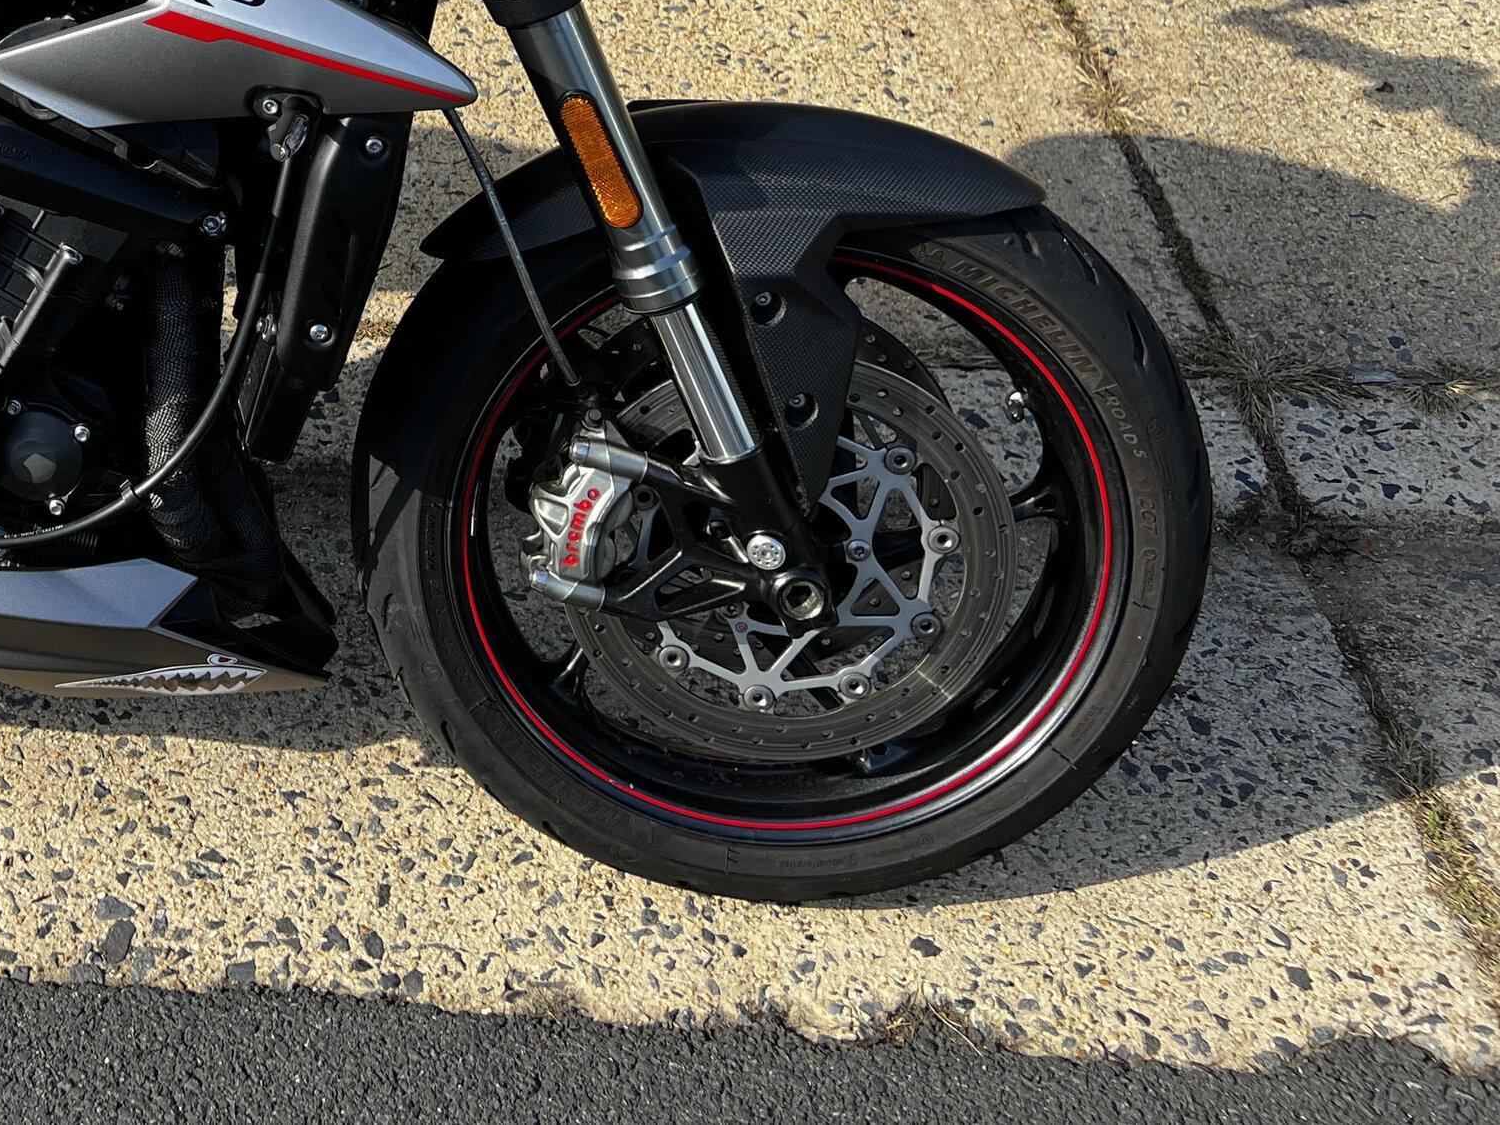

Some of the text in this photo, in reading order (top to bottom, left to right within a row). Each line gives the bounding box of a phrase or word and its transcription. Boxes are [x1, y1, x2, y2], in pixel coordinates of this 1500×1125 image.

[950, 260, 1098, 374] MICHELIN
[1105, 394, 1138, 446] ROAD
[559, 487, 601, 567] brembo
